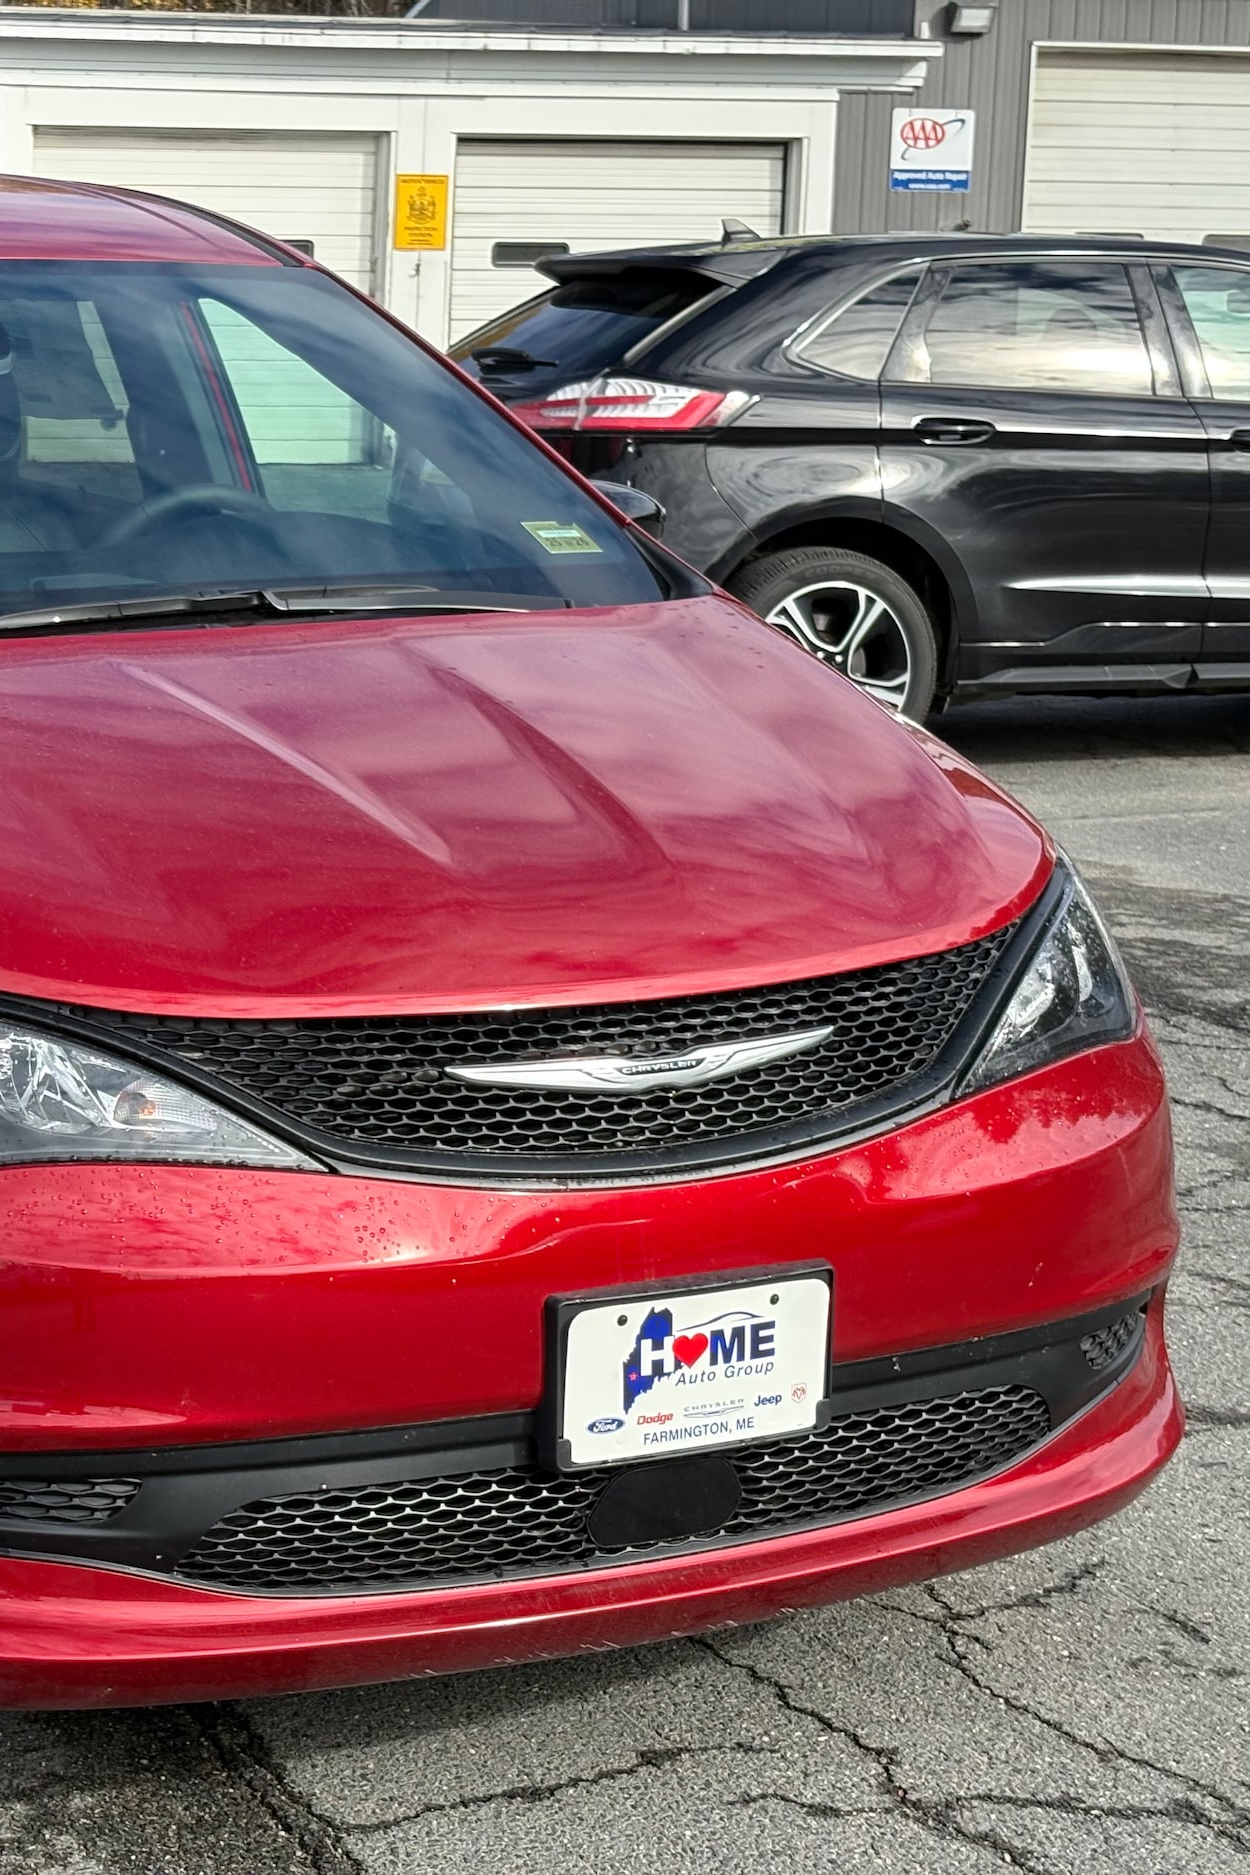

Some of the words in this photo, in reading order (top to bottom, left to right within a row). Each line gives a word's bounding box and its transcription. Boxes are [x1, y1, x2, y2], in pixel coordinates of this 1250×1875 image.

[621, 1060, 697, 1074] CHRYSLER
[675, 1371, 716, 1387] Auto
[724, 1360, 775, 1378] Group
[683, 1398, 745, 1412] CHRYSLER
[754, 1394, 783, 1408] Jeep
[592, 1418, 620, 1433] Ford
[636, 1412, 674, 1426] Dodge
[643, 1422, 733, 1446] FARMINGTON,
[736, 1416, 755, 1430] ME
